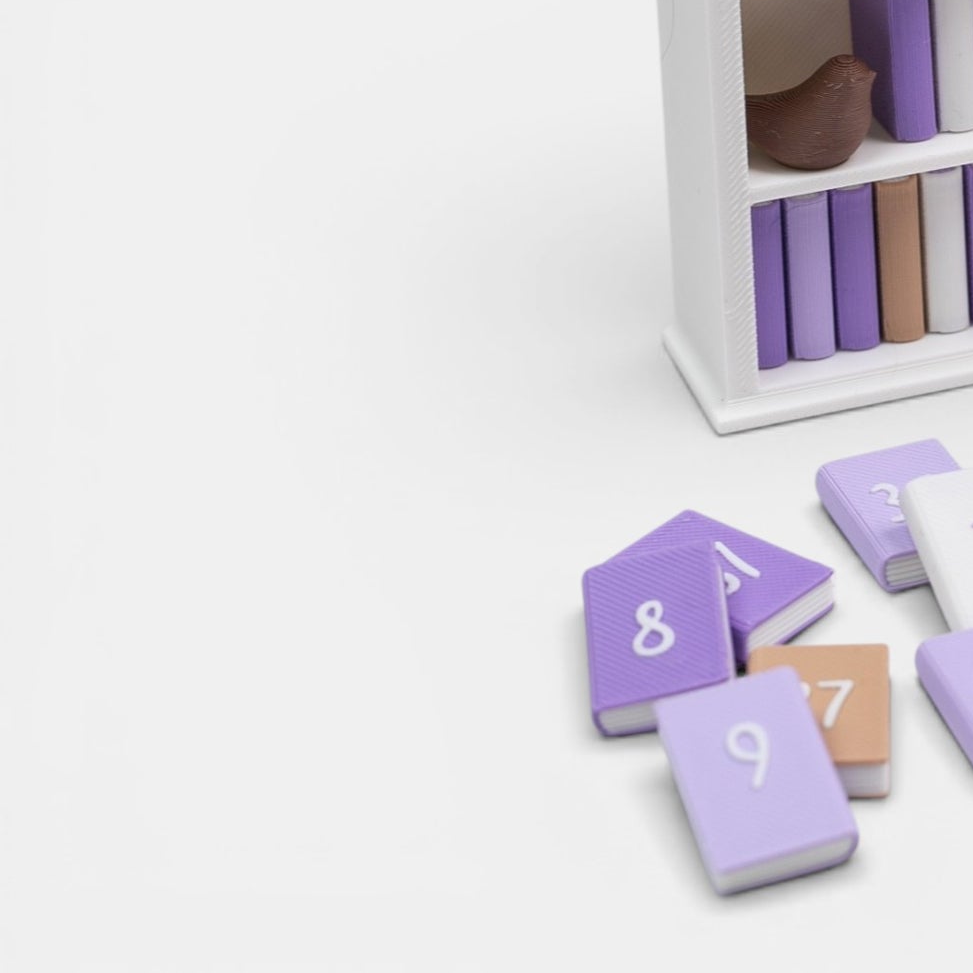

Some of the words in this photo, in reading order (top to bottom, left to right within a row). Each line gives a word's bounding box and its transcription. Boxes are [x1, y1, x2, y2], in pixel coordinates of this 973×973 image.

[633, 600, 675, 657] 8
[800, 679, 854, 728] 7
[726, 722, 769, 789] 9
